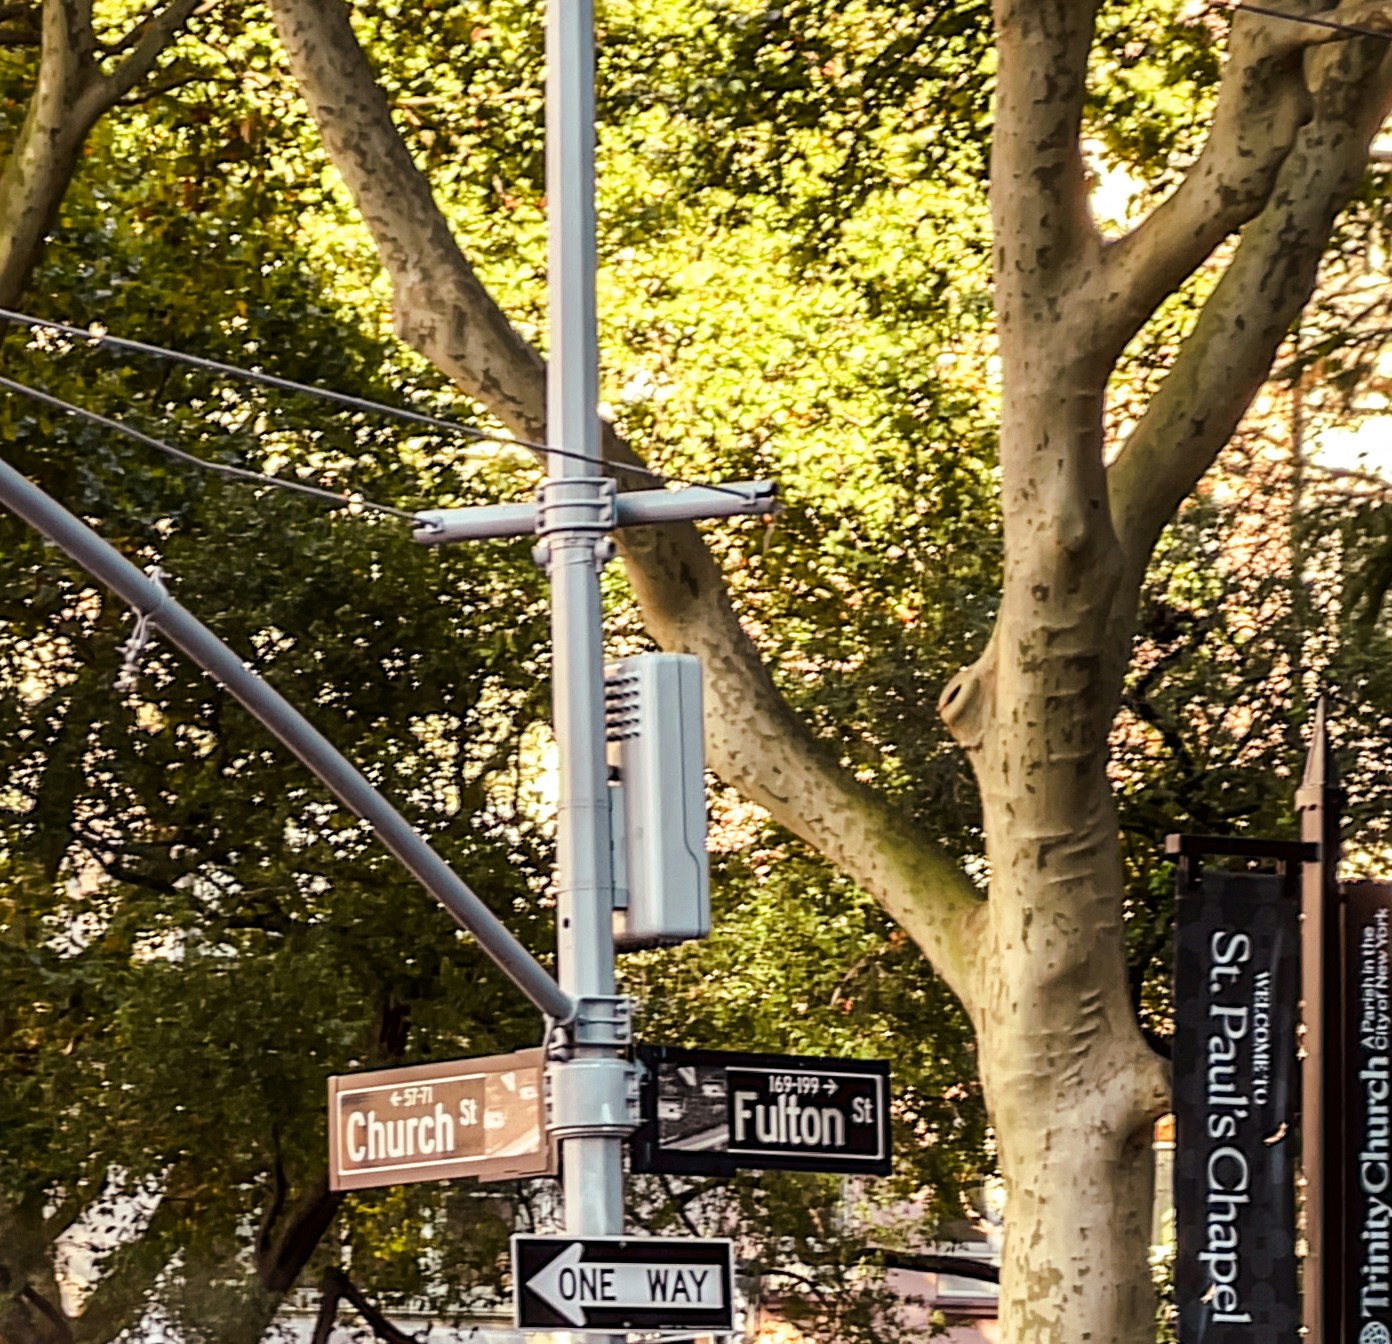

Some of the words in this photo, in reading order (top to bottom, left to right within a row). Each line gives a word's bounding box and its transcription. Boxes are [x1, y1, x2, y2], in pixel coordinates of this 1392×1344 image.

[1210, 931, 1252, 993] St.
[1253, 970, 1271, 1072] WELCOME
[768, 1075, 819, 1094] 169-199
[1207, 1005, 1250, 1140] Paul's
[1252, 1074, 1269, 1105] TO
[347, 1102, 454, 1162] Church
[459, 1098, 478, 1126] St
[734, 1091, 846, 1147] Fulton
[851, 1096, 874, 1124] St
[1359, 1056, 1390, 1194] Church
[1199, 1146, 1253, 1324] Chapel
[1359, 1196, 1392, 1318] Trinity
[559, 1268, 616, 1301] ONE
[647, 1269, 708, 1302] WAY
